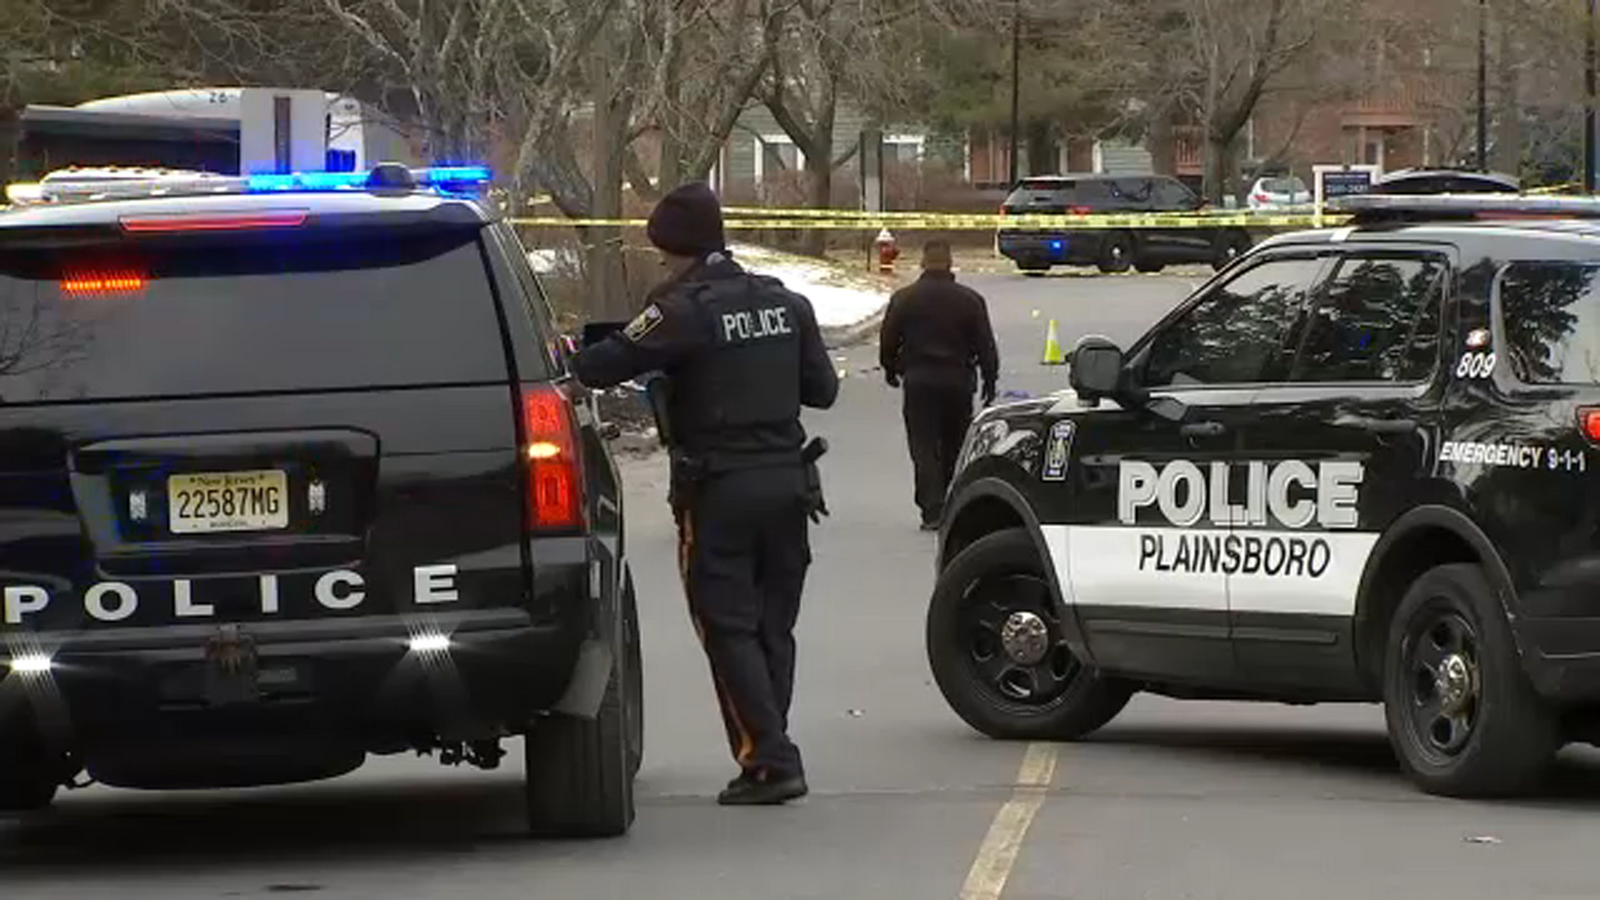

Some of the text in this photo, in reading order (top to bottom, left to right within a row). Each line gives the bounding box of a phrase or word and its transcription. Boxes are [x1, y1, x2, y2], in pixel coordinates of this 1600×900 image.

[722, 306, 792, 341] POLICE
[1456, 353, 1497, 378] 809
[1439, 441, 1586, 472] EMERGENCY 9-1-1
[177, 486, 279, 519] 22587MG
[1117, 459, 1366, 528] POLICE
[1138, 534, 1332, 578] PLAINSBORO
[3, 563, 460, 624] POLICE
